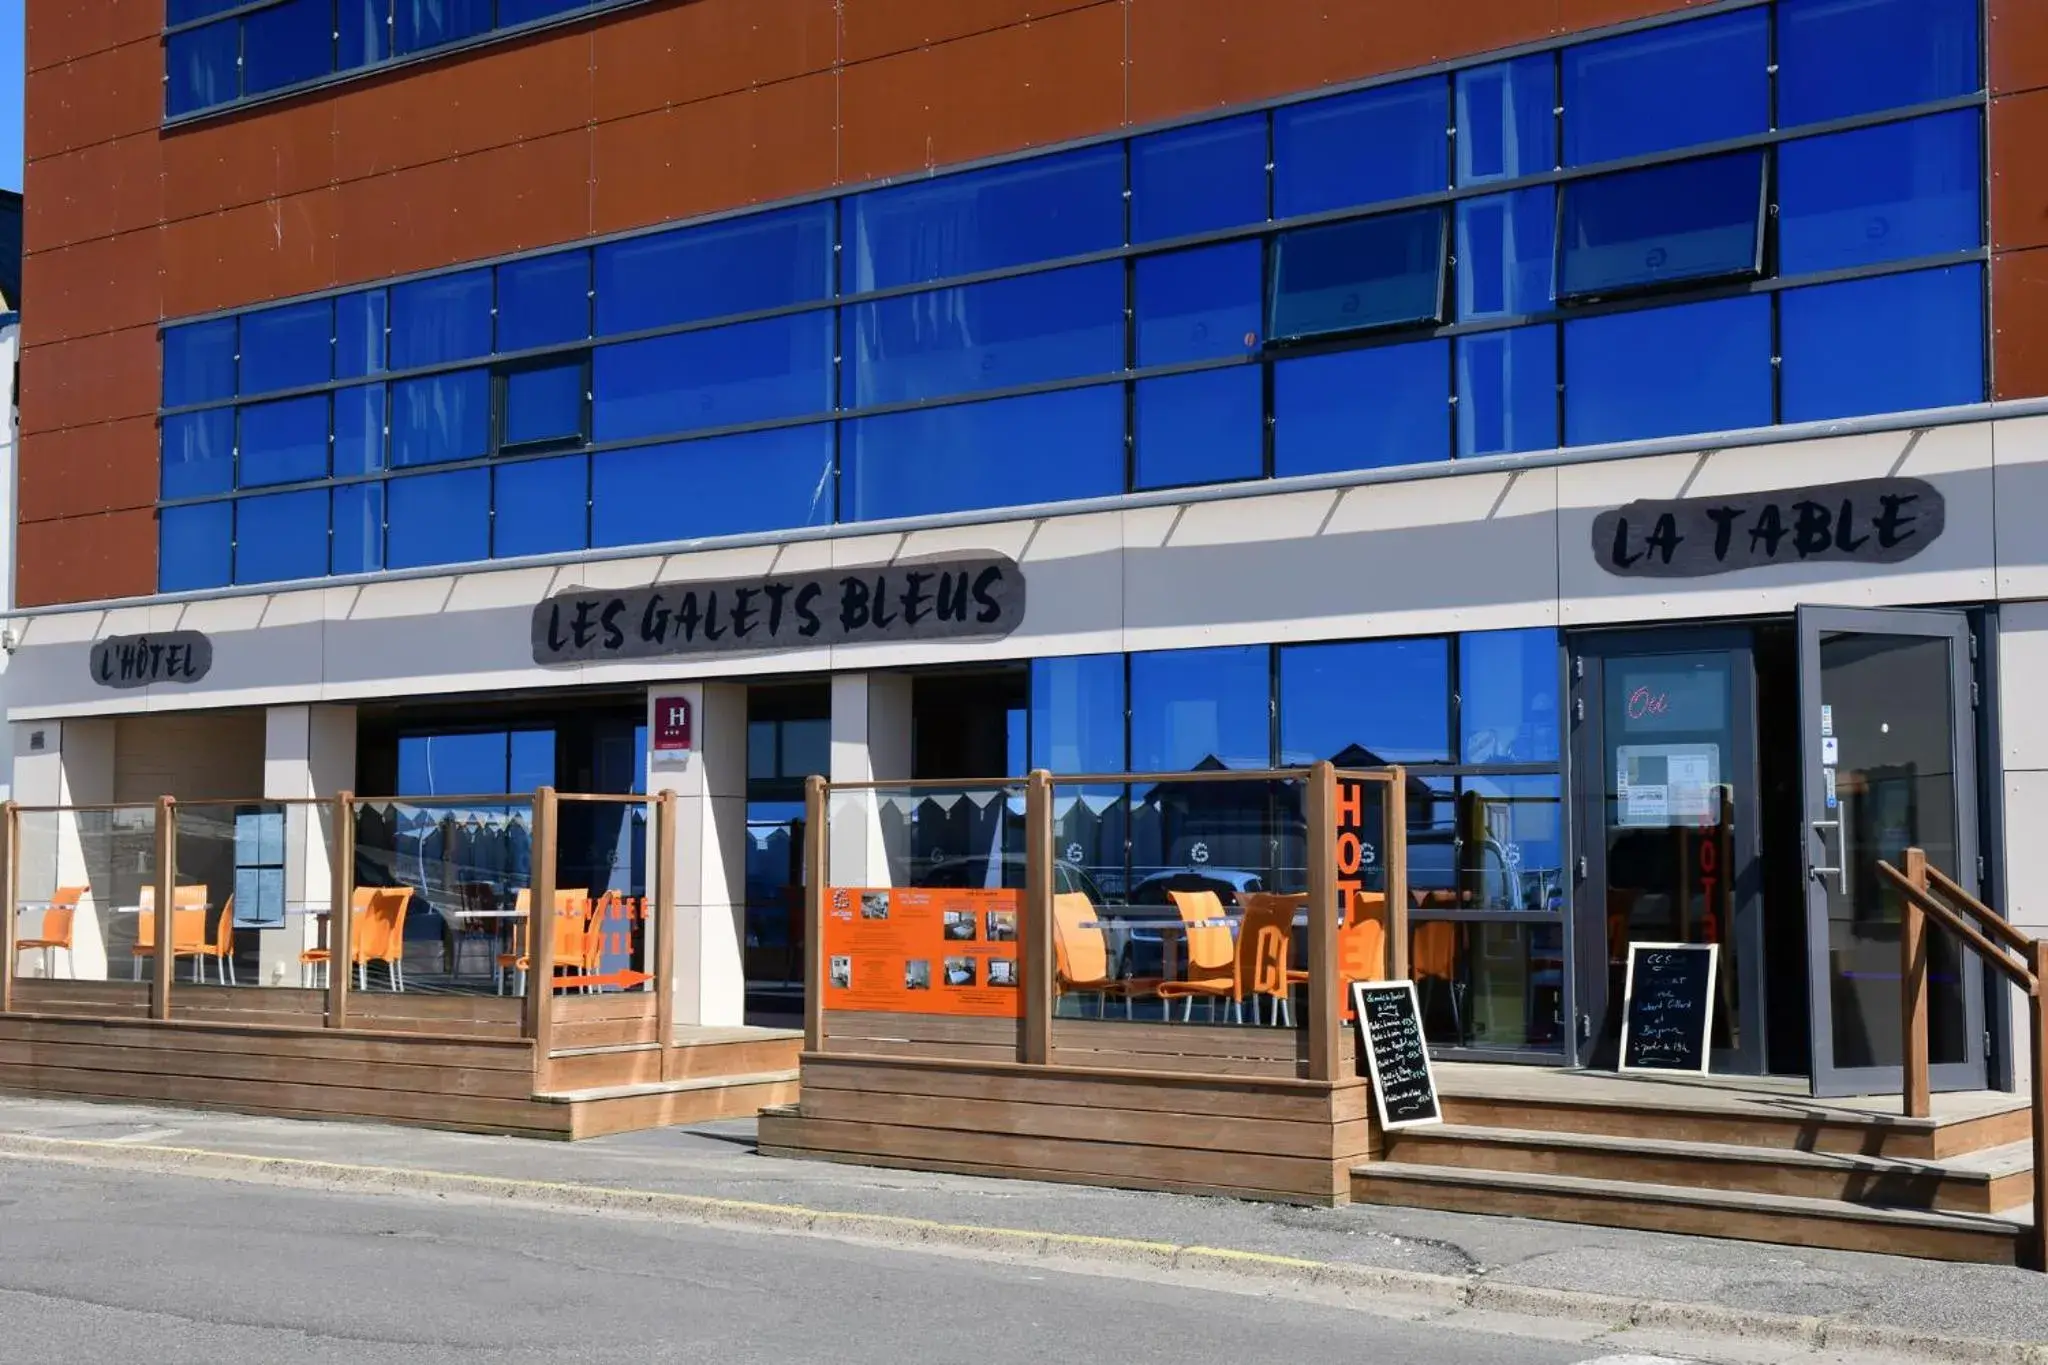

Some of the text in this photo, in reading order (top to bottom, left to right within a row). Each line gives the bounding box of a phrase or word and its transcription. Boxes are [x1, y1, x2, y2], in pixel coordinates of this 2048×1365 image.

[1612, 493, 1919, 569] LA TABLE
[547, 565, 1004, 652] LES GALETS BLEUS
[102, 636, 197, 681] L'HÔTEL
[669, 706, 685, 726] H
[1335, 784, 1362, 1022] HOTEL
